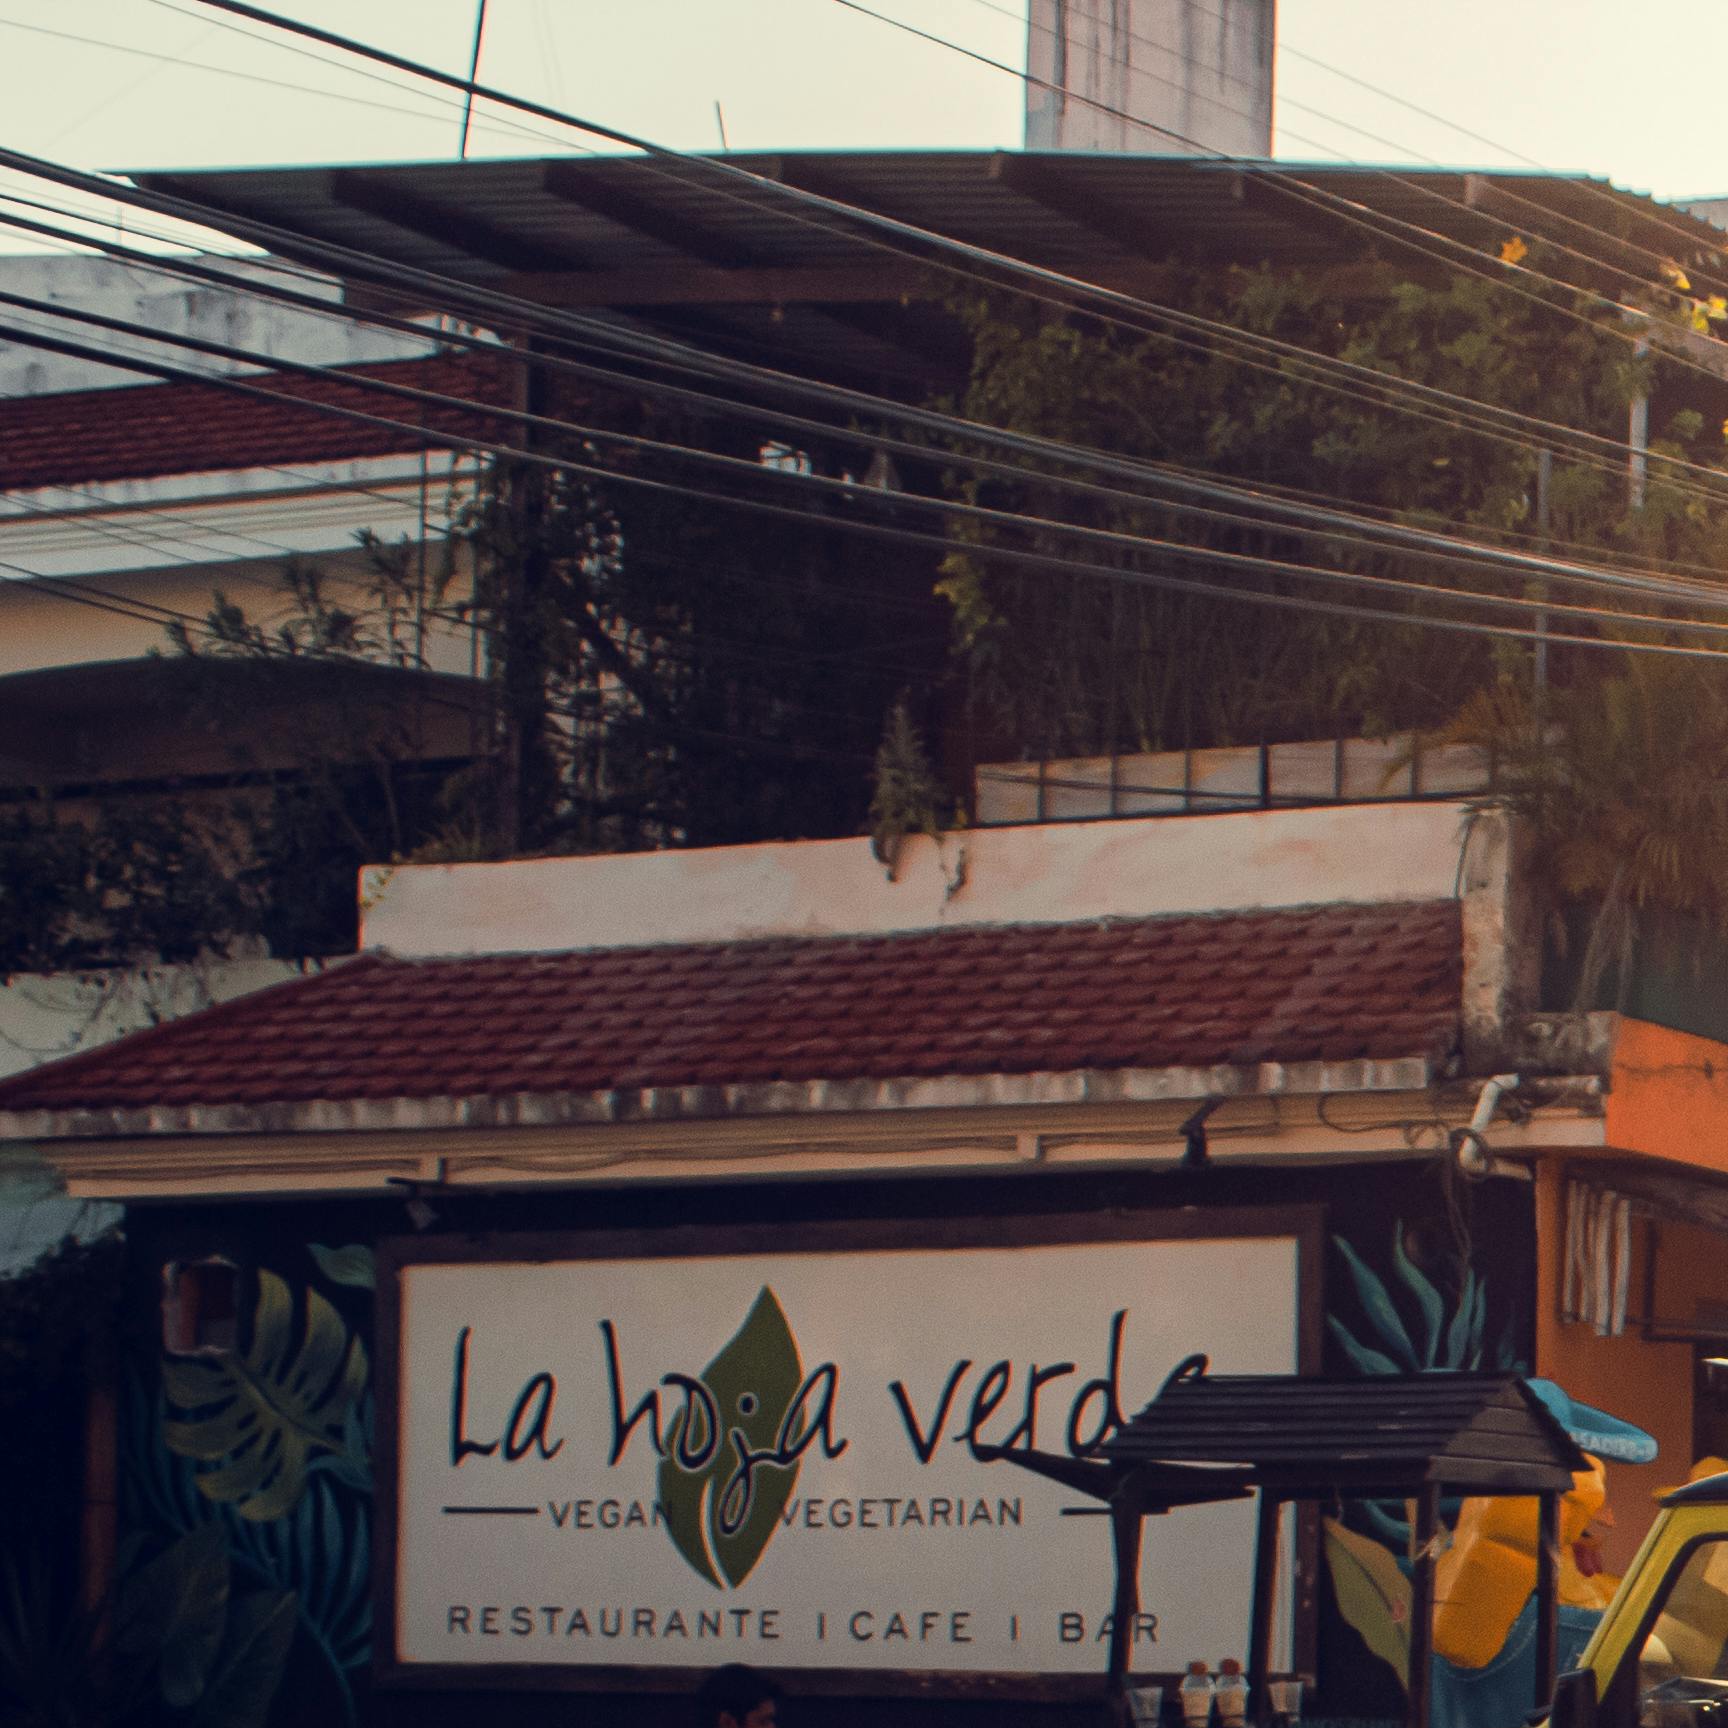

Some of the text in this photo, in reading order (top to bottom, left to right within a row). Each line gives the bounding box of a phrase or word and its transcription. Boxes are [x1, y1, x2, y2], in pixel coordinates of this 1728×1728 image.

[451, 1327, 563, 1467] La
[600, 1320, 848, 1535] hoja
[549, 1497, 1023, 1529] VEGAN VEGETARIAN
[447, 1605, 780, 1639] RESTAURANTE
[848, 1612, 973, 1643] CAFE
